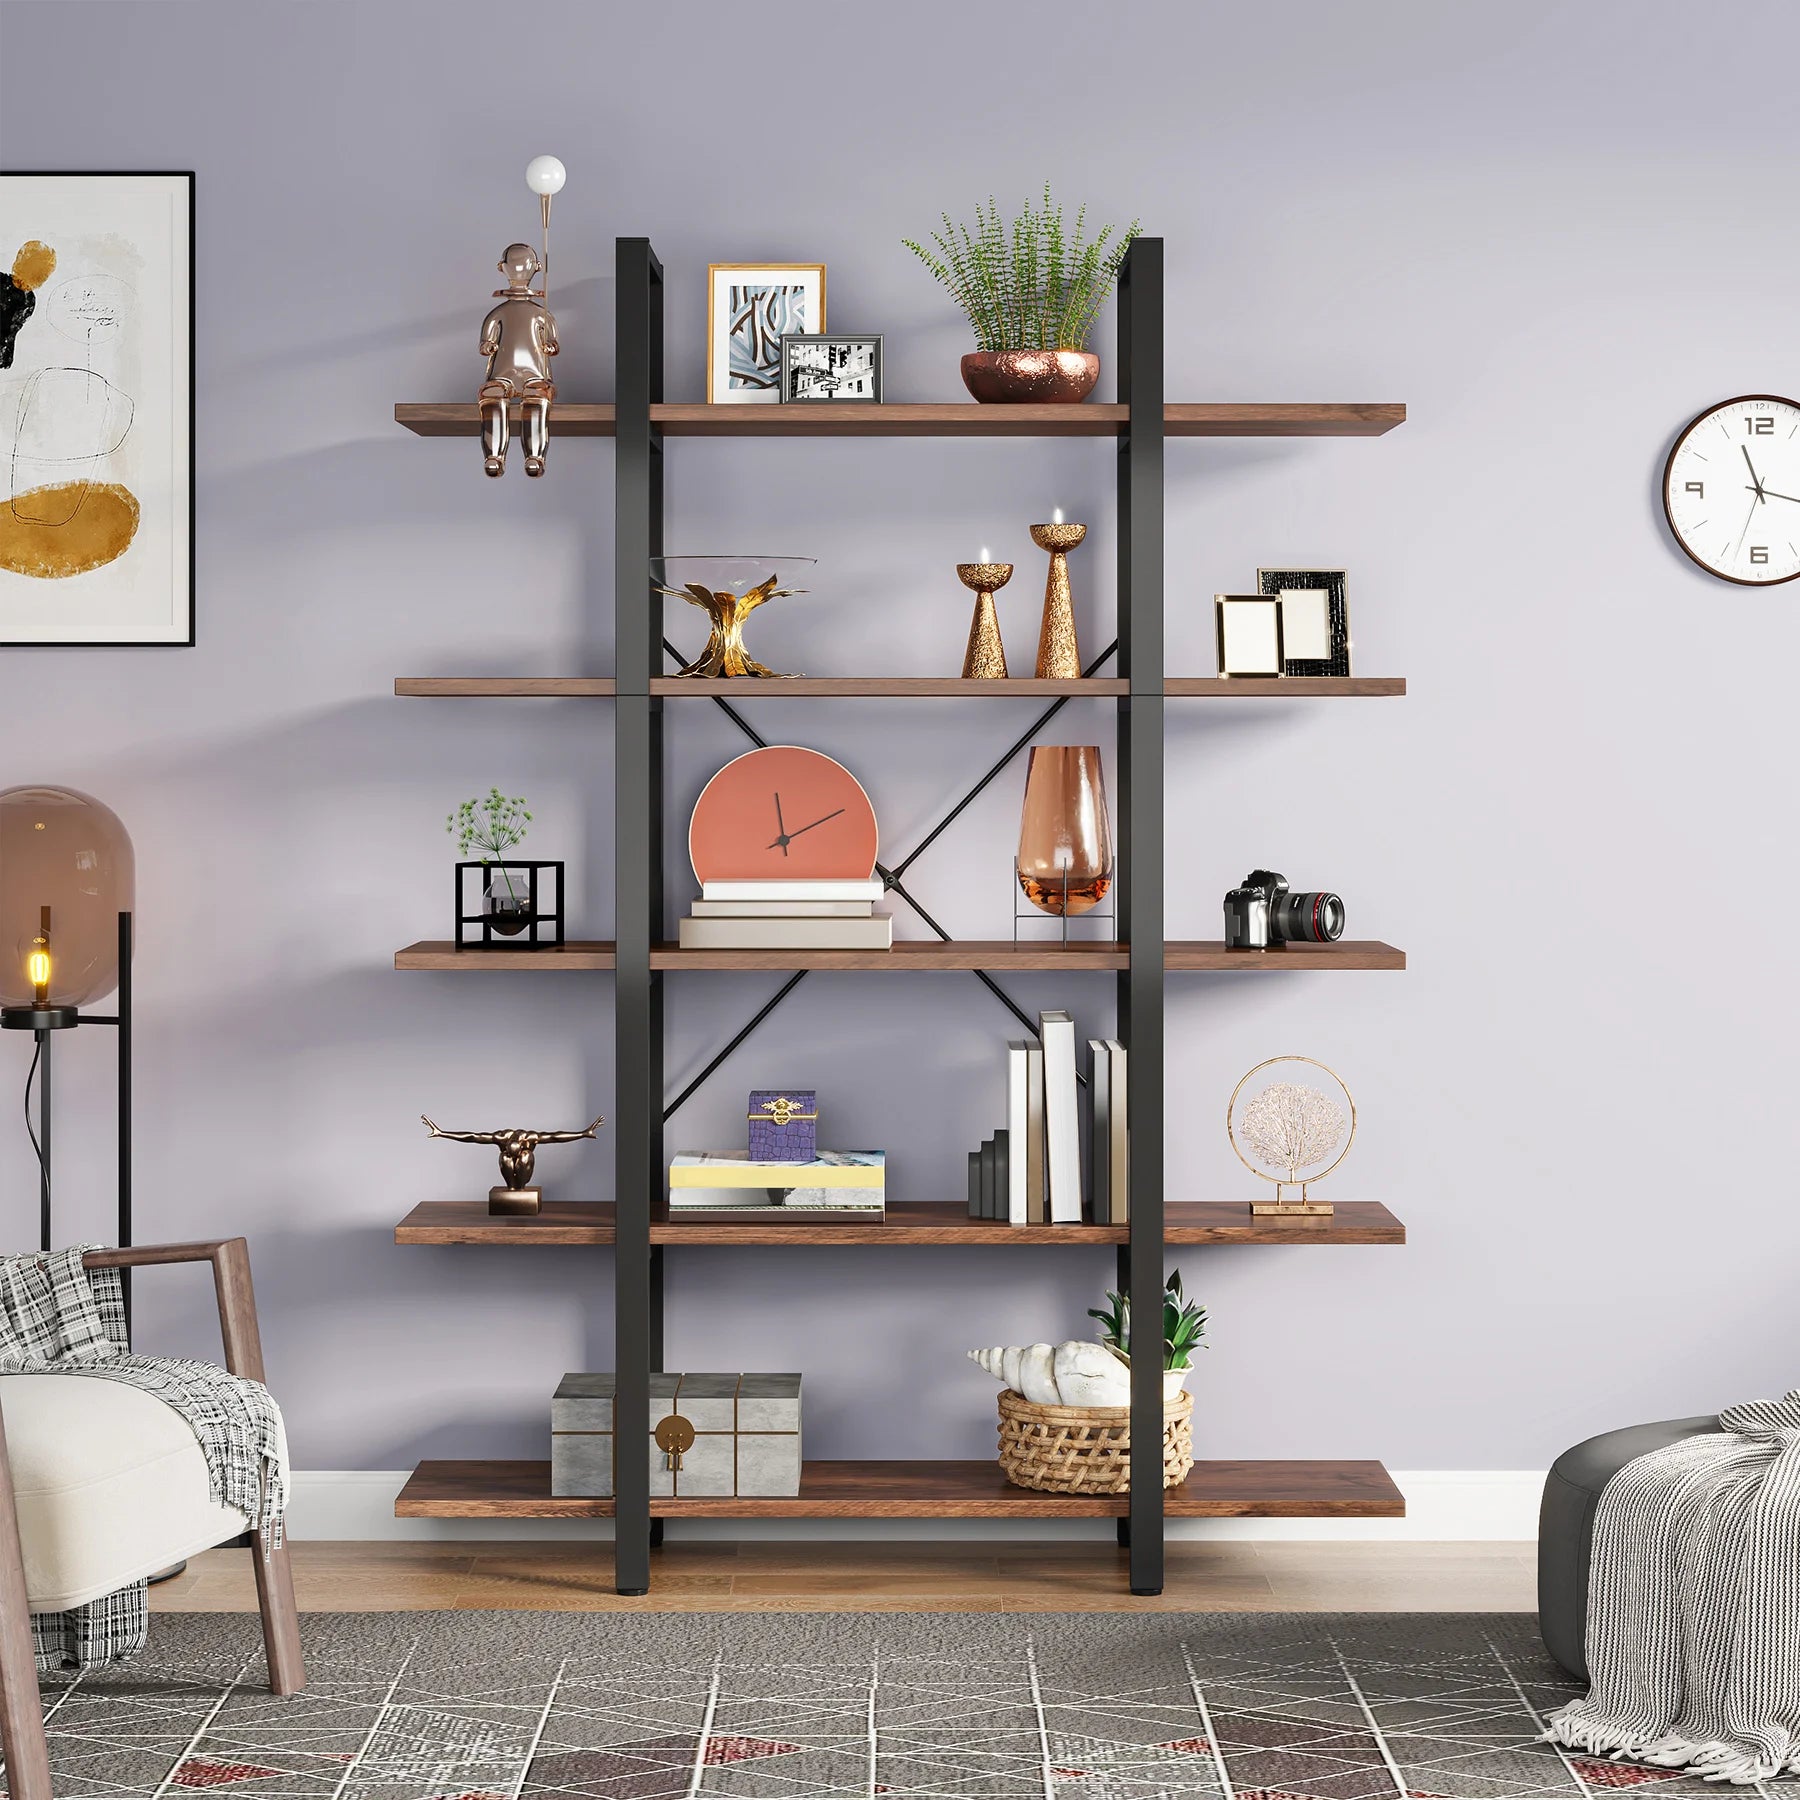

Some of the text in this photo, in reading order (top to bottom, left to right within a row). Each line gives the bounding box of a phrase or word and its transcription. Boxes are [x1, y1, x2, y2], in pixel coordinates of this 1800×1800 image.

[1745, 417, 1774, 435] 12
[1685, 482, 1703, 499] 9
[1750, 546, 1768, 564] 6
